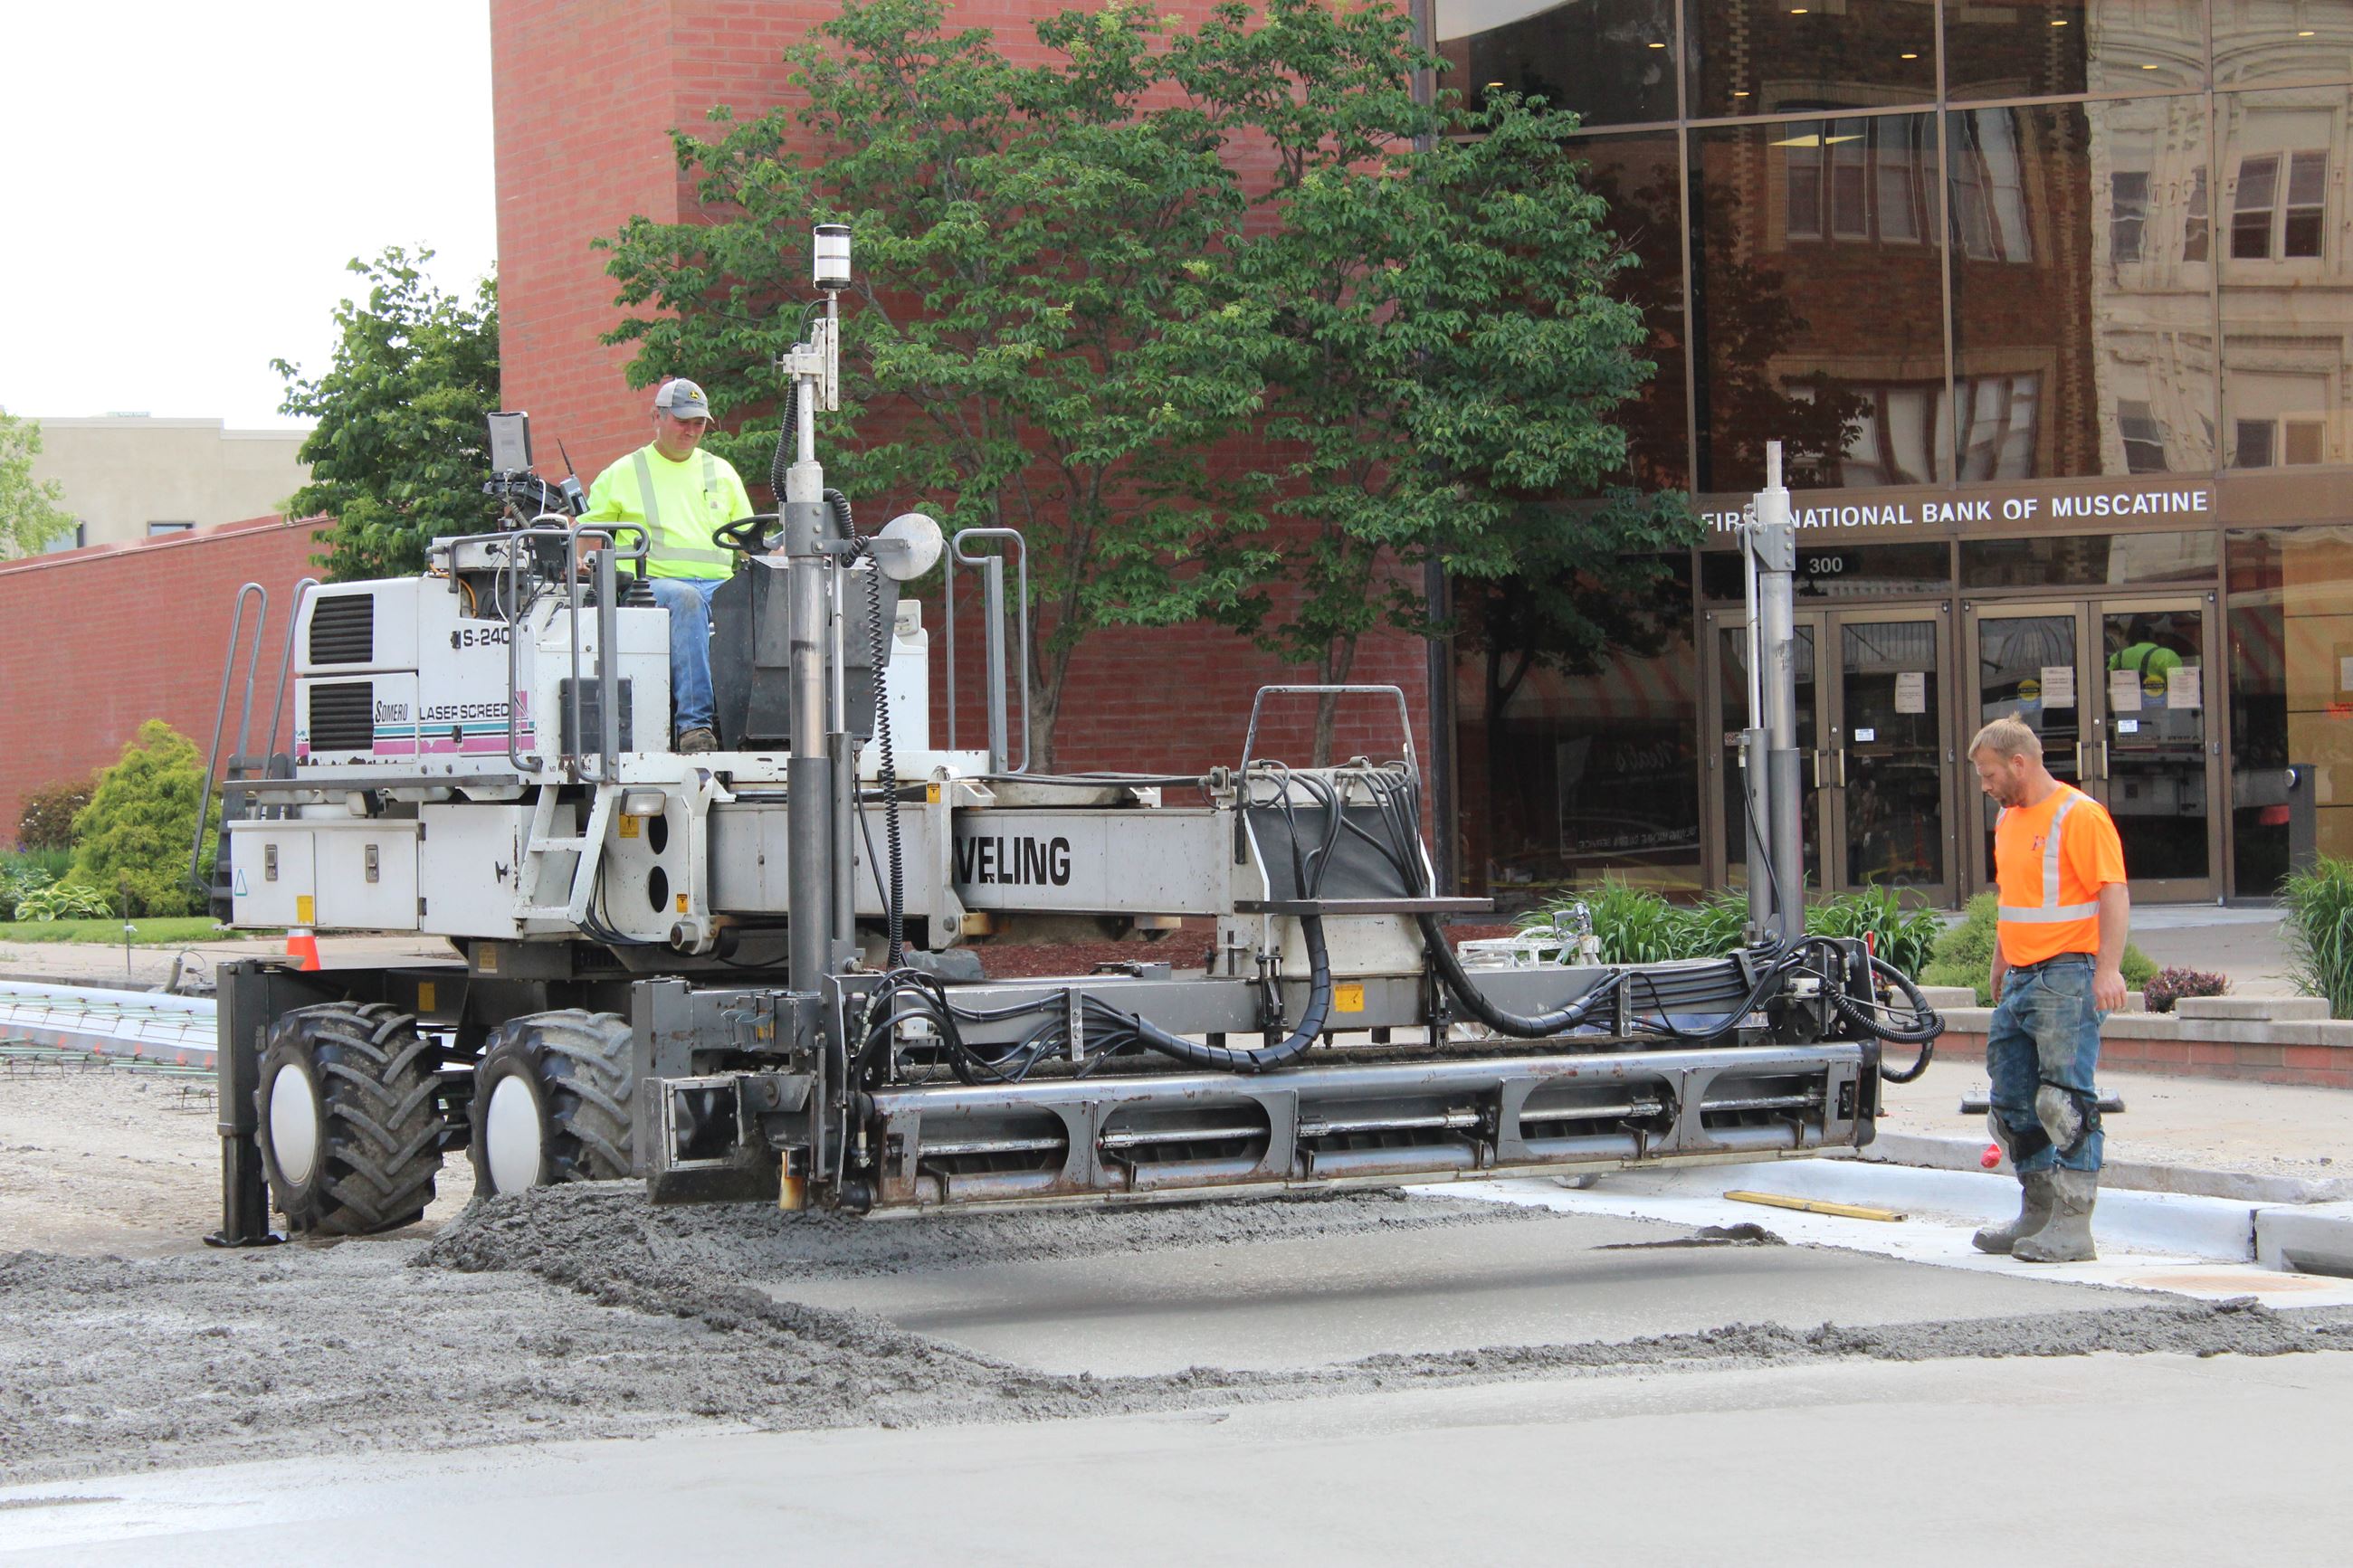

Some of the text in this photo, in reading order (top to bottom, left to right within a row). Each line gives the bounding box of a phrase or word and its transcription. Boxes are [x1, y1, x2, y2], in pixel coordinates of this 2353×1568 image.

[1701, 491, 2208, 532] FIR NATIONAL BANK OF MUSCATINE
[1810, 556, 1843, 574] 300
[460, 703, 510, 719] SCREED
[956, 836, 1071, 886] VELING
